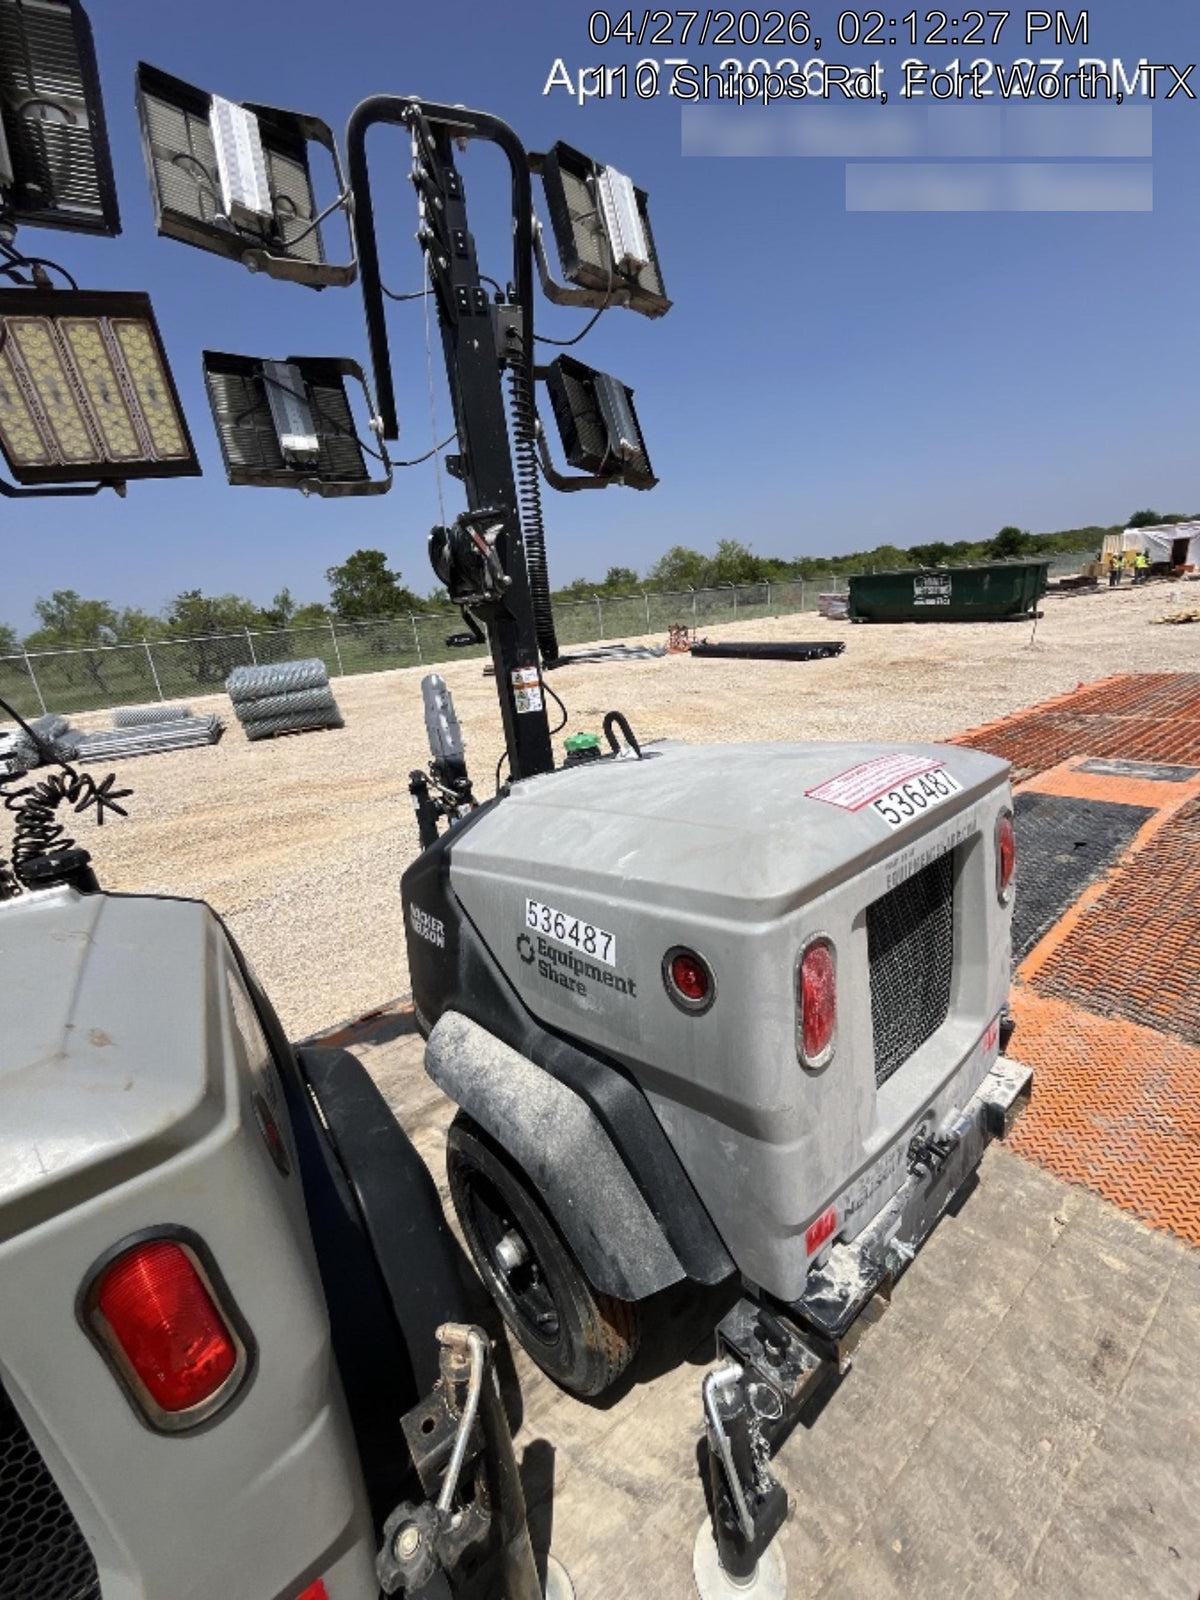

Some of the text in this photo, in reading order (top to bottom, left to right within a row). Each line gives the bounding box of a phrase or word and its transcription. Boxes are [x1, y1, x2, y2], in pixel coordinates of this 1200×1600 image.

[872, 768, 958, 825] 536487
[527, 900, 613, 961] 536487
[537, 936, 637, 998] Equipment
[538, 959, 588, 997] Share
